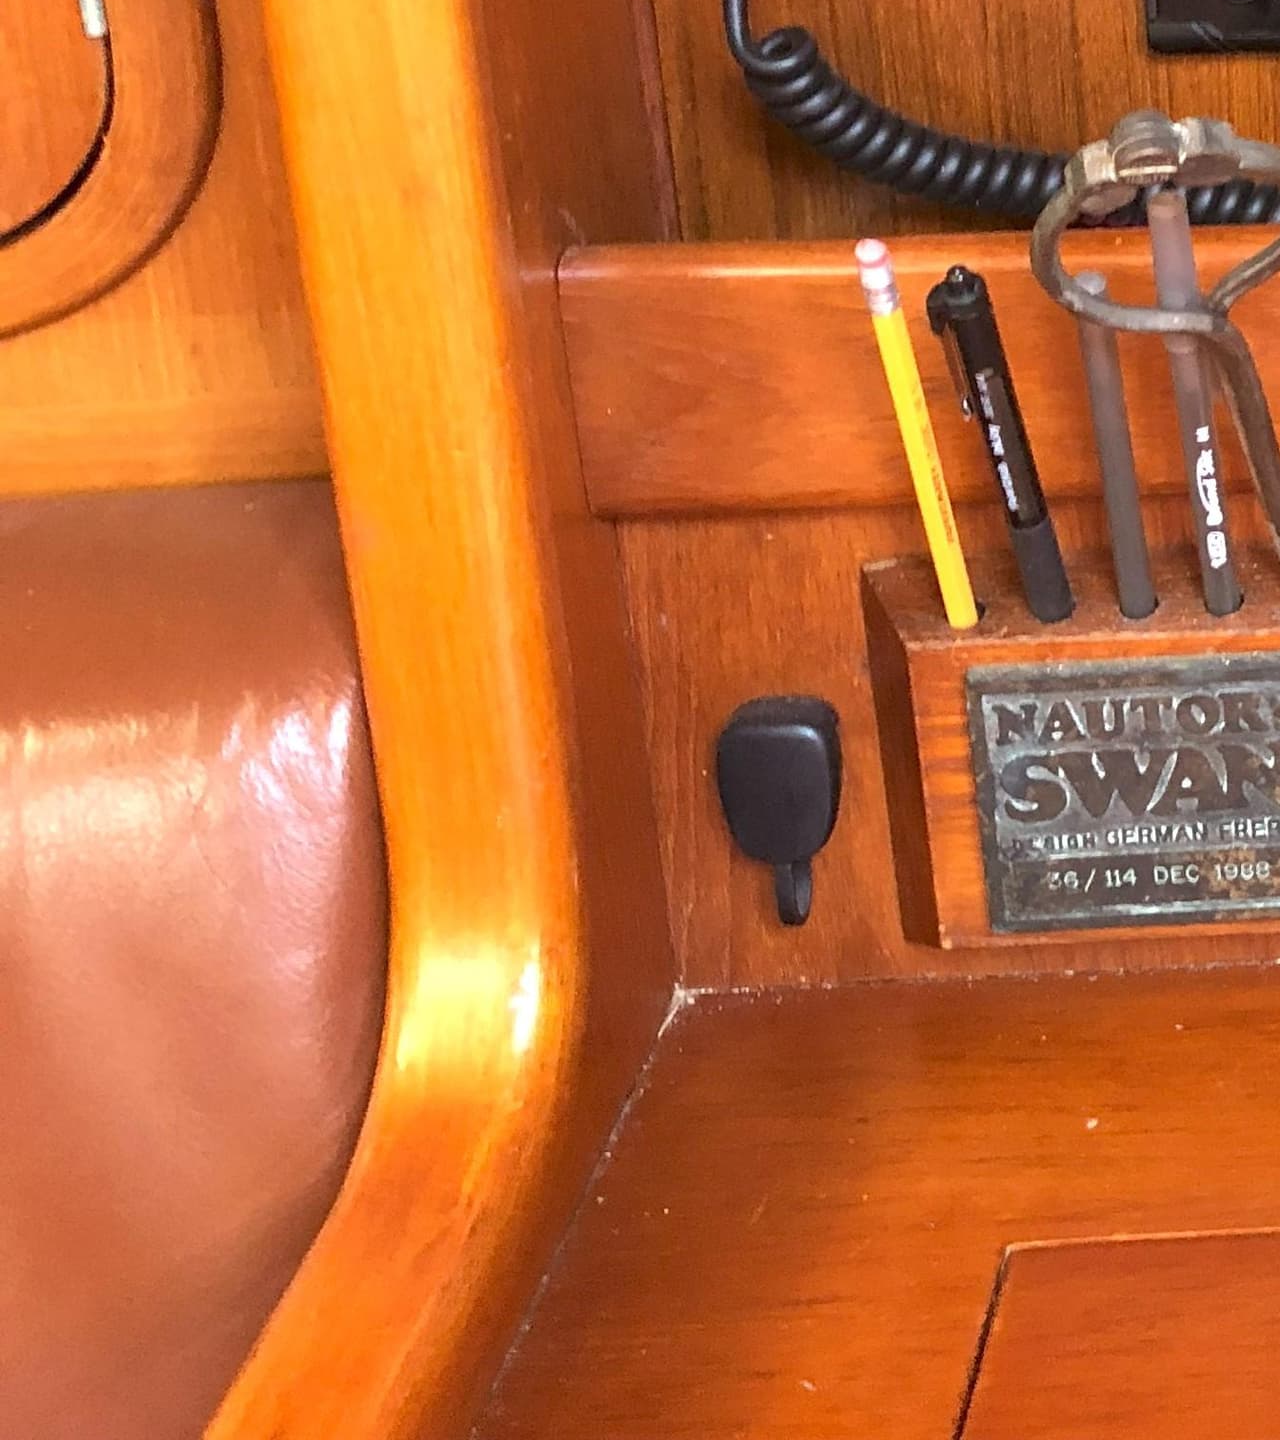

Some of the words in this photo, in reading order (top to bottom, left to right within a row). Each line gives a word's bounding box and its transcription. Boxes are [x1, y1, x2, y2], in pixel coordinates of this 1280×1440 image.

[1106, 820, 1205, 847] GERMAN
[1153, 863, 1200, 886] DEC
[1213, 860, 1271, 882] 1988
